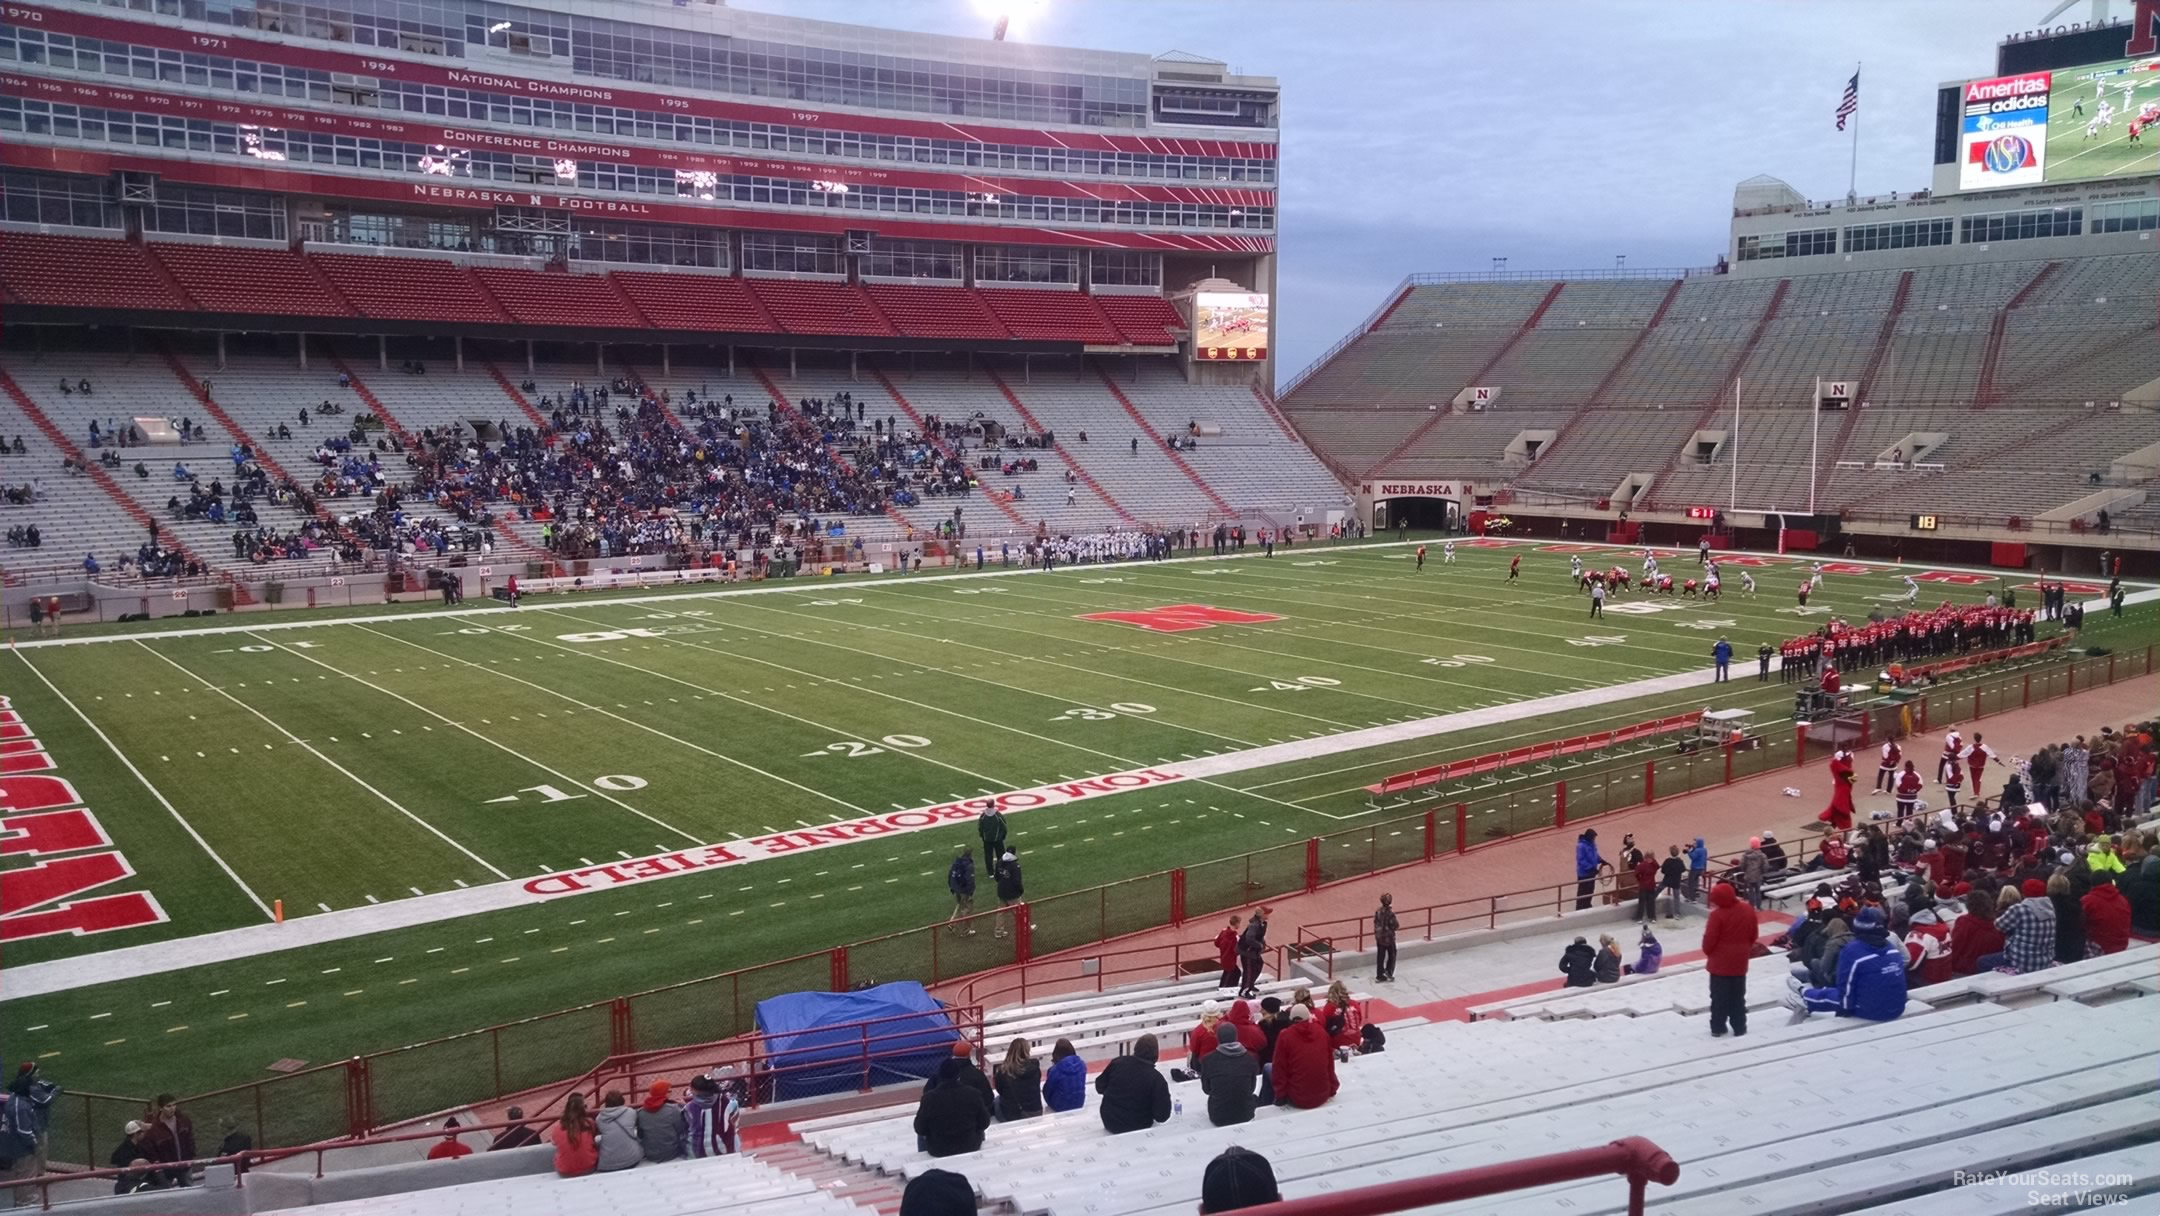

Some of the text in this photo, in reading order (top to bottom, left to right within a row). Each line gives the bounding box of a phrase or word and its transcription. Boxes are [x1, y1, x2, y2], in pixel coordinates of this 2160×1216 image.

[0, 7, 43, 22] 1970
[2006, 16, 2121, 45] MEMORIAL
[191, 36, 228, 49] 1971
[361, 60, 396, 72] 1994
[448, 71, 612, 101] NATIONAL CHAMPIONS
[1966, 78, 2046, 101] Ameritas
[660, 98, 689, 109] 1995
[1991, 94, 2047, 113] adidas
[0, 77, 28, 87] 1964
[37, 82, 62, 92] 1965
[73, 87, 98, 97] 1966
[109, 91, 134, 101] 1969
[144, 96, 170, 105] 1970
[179, 100, 203, 109] 1971
[216, 105, 241, 114] 1972
[314, 116, 337, 125] 1981
[348, 120, 372, 129] 1982
[381, 124, 404, 132] 1983
[443, 129, 541, 149] CONFERENCE
[547, 140, 631, 157] CHAMPIONS
[658, 153, 678, 161] 1984
[739, 160, 759, 168] 1992
[792, 112, 819, 122] 1997
[414, 184, 515, 203] NEBRASKA
[559, 197, 649, 213] FOOTBALL
[1477, 389, 1489, 399] N
[1832, 384, 1846, 396] N
[1362, 484, 1372, 494] N
[1382, 484, 1453, 495] NEBRASKA
[1463, 485, 1473, 495] N
[1071, 603, 1290, 633] N
[1425, 654, 1495, 668] 50
[1268, 675, 1342, 691] 40
[1065, 702, 1156, 721] 30
[826, 734, 932, 758] 20
[518, 774, 648, 803] 10
[523, 769, 1184, 895] TOM OSBORNE FIELD
